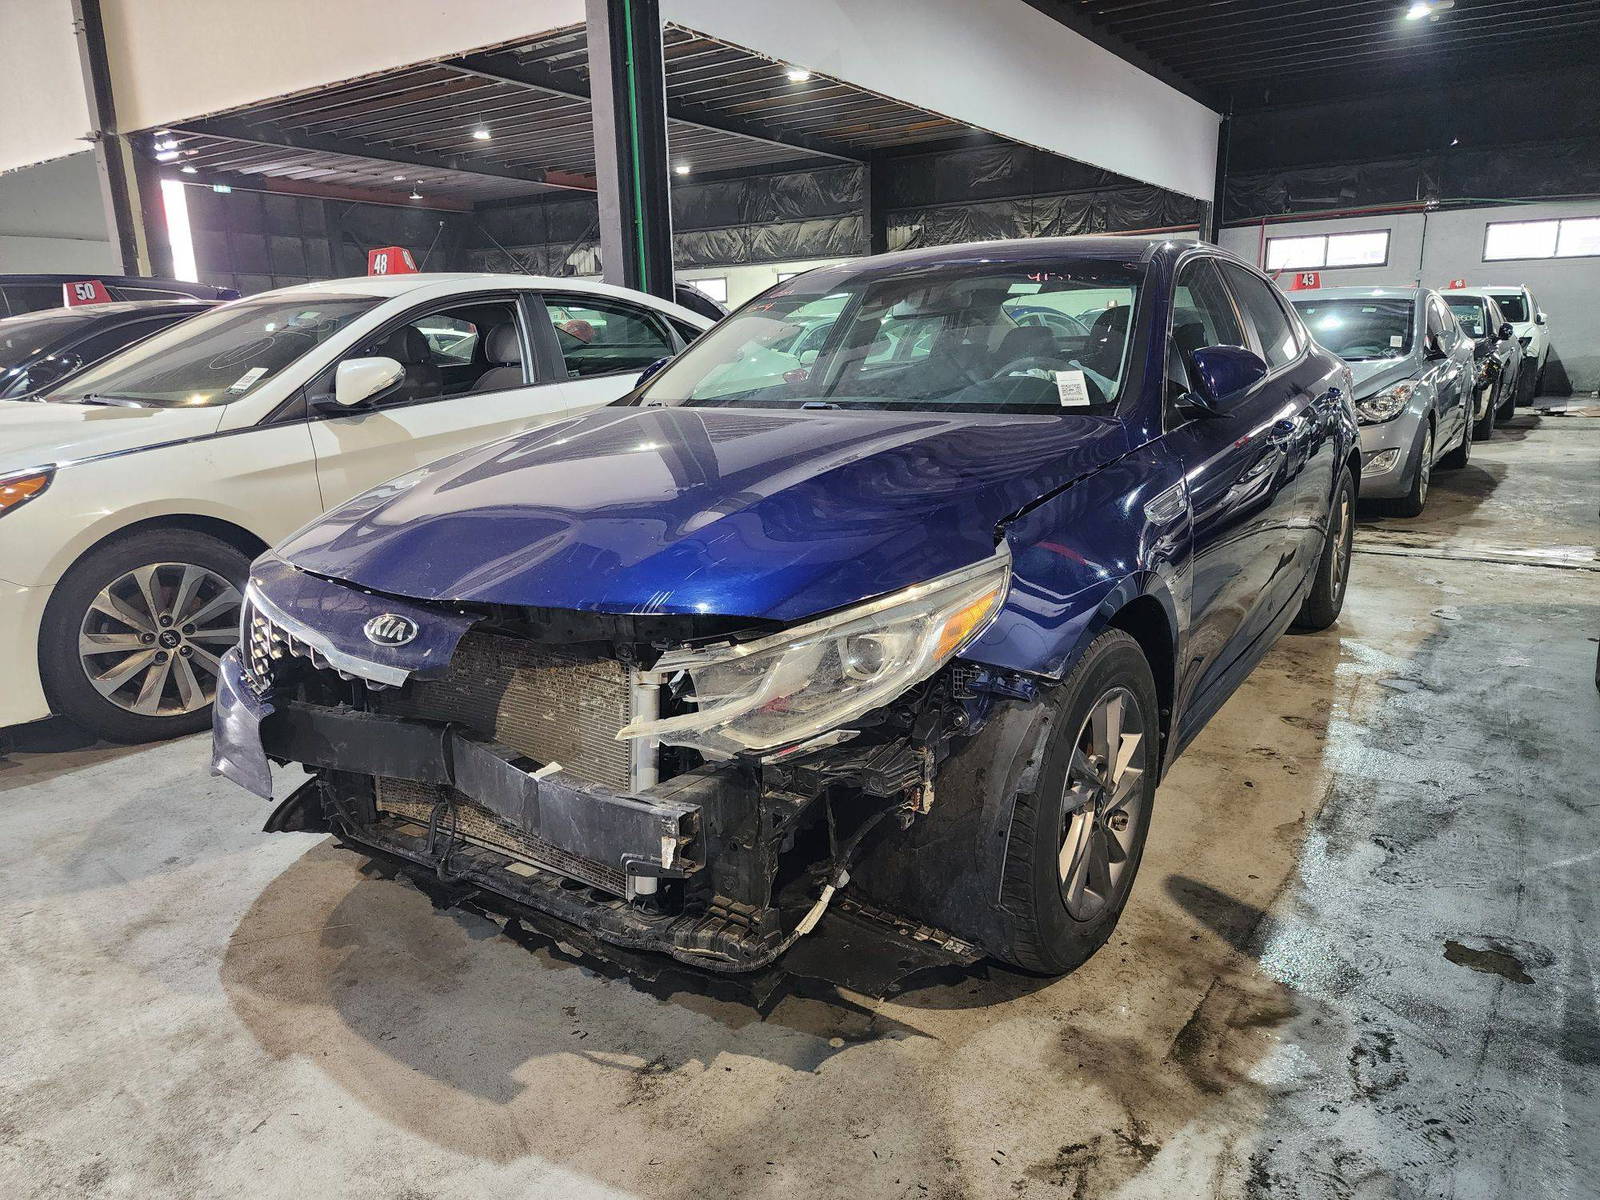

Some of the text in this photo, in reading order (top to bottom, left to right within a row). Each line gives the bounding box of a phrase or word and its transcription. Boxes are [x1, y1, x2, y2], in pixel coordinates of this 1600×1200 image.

[374, 254, 388, 274] 48
[1302, 273, 1314, 286] 43
[74, 283, 96, 301] 50
[370, 616, 407, 641] KIA
